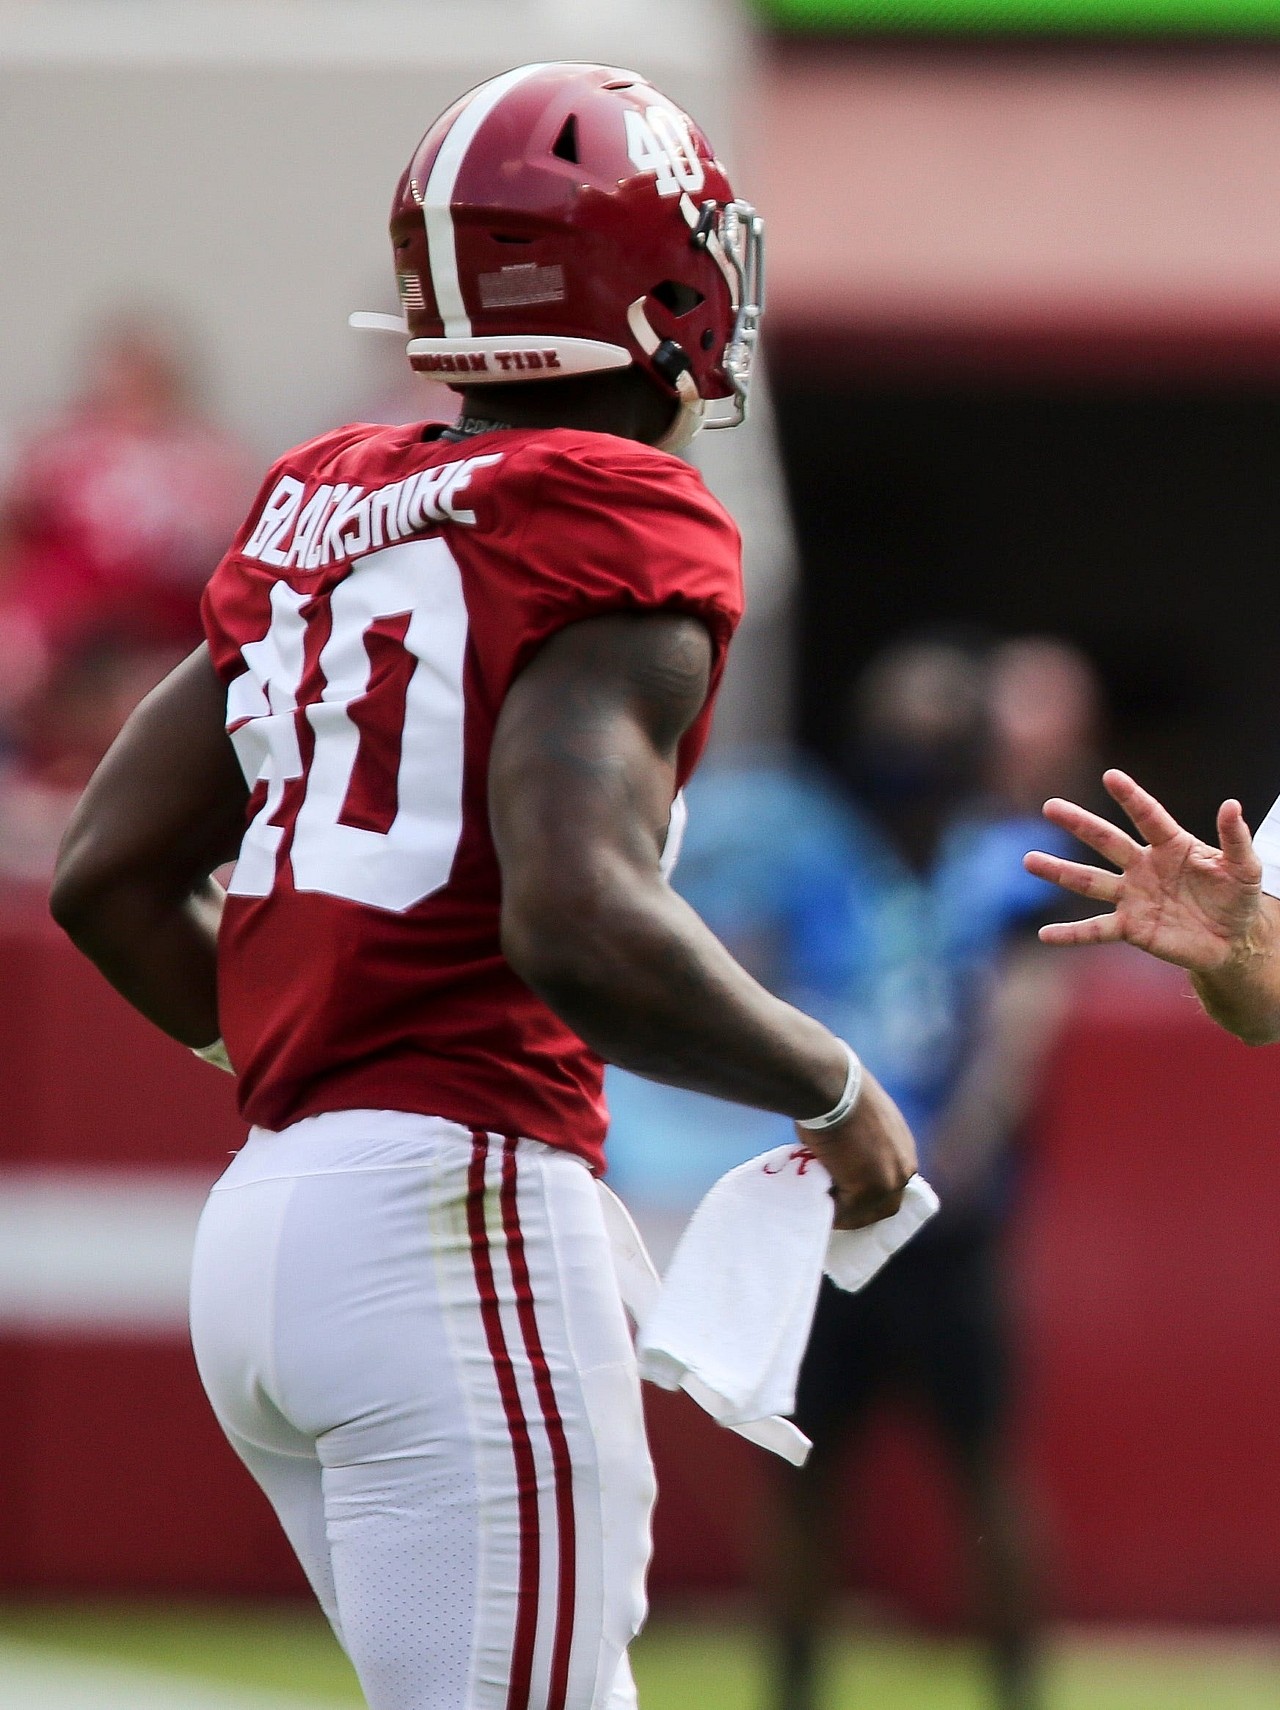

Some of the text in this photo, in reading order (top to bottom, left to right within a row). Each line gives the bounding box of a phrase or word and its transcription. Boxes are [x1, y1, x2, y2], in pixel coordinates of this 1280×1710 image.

[623, 106, 705, 196] 40
[494, 350, 561, 370] TIDE
[226, 536, 469, 913] 40
